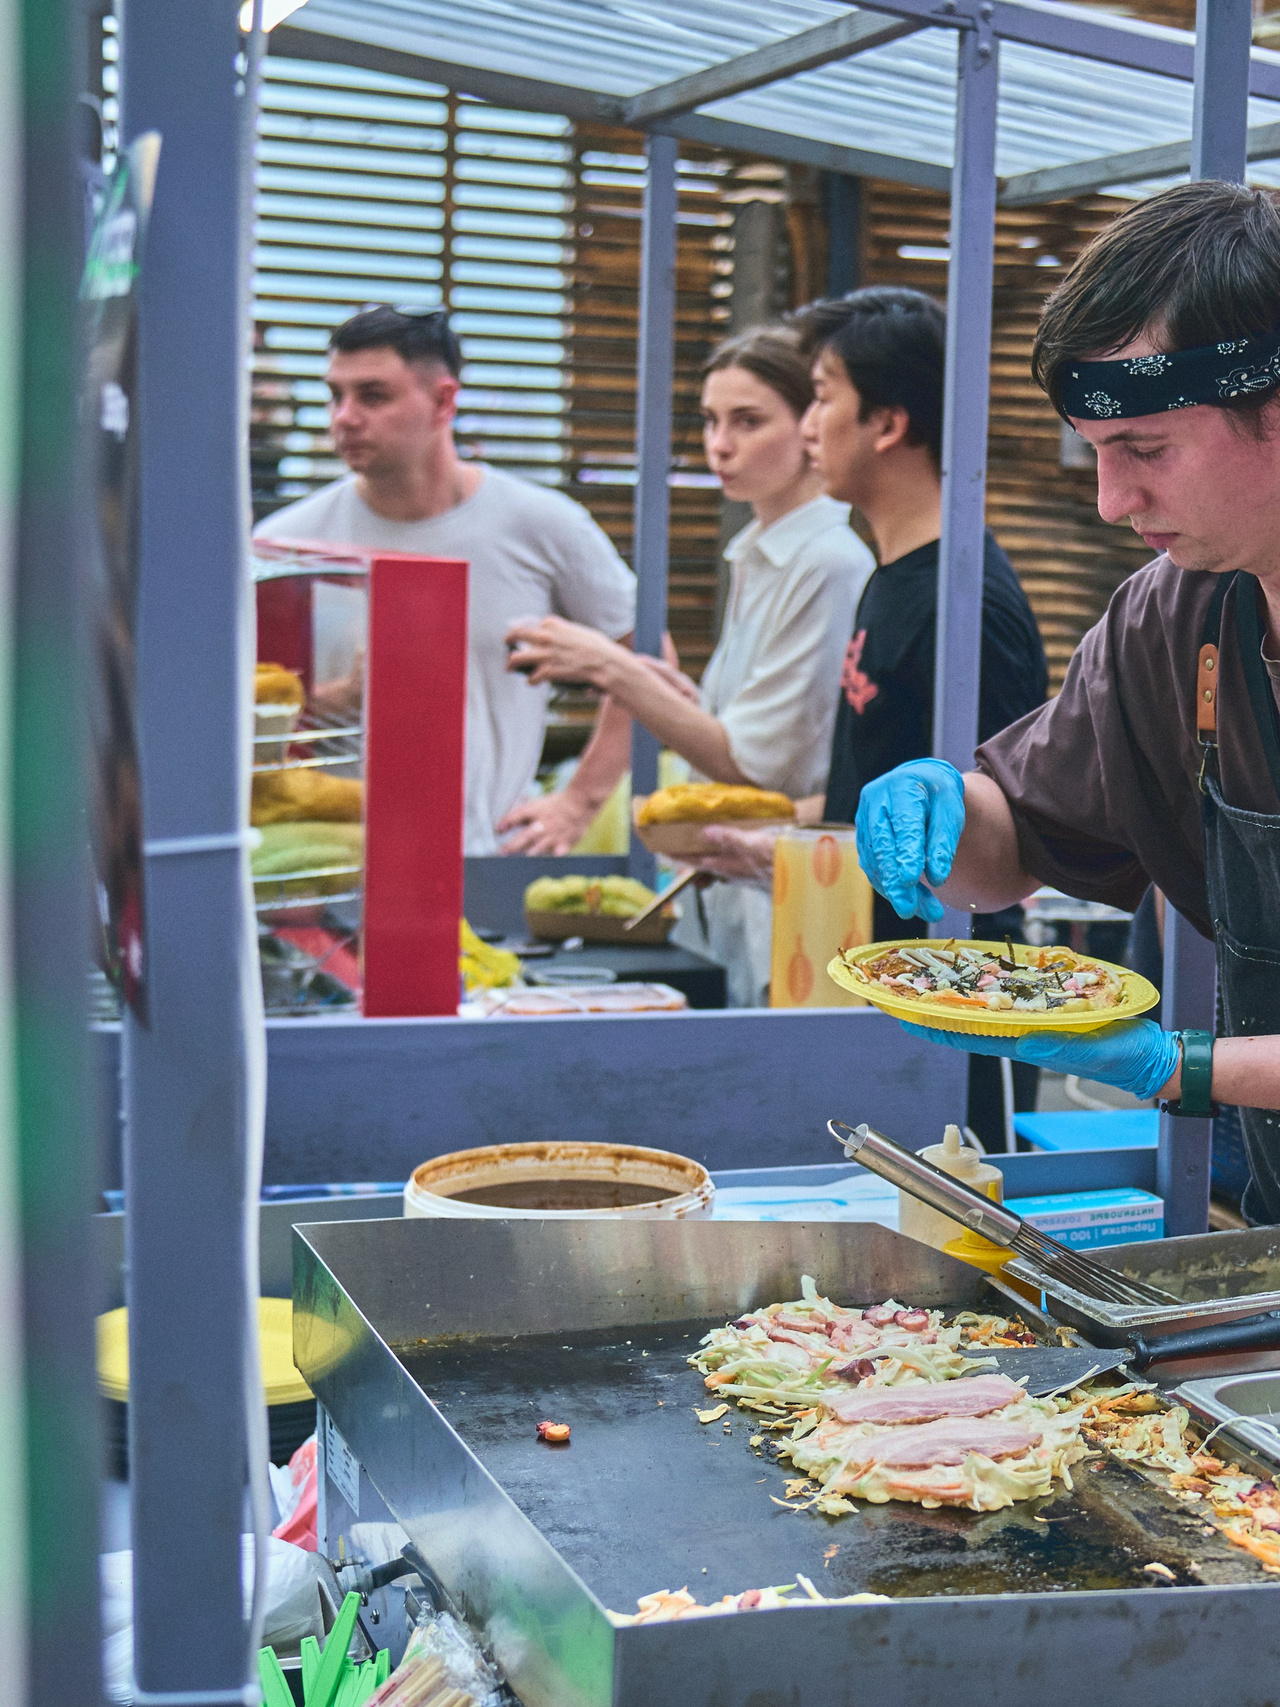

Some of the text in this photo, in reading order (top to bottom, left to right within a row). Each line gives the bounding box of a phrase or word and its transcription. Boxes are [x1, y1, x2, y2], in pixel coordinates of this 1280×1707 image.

[1090, 1207, 1155, 1221] НИТРИЛОВЫЕ
[1069, 1231, 1091, 1241] 100
[1101, 1222, 1156, 1236] Перчатки
